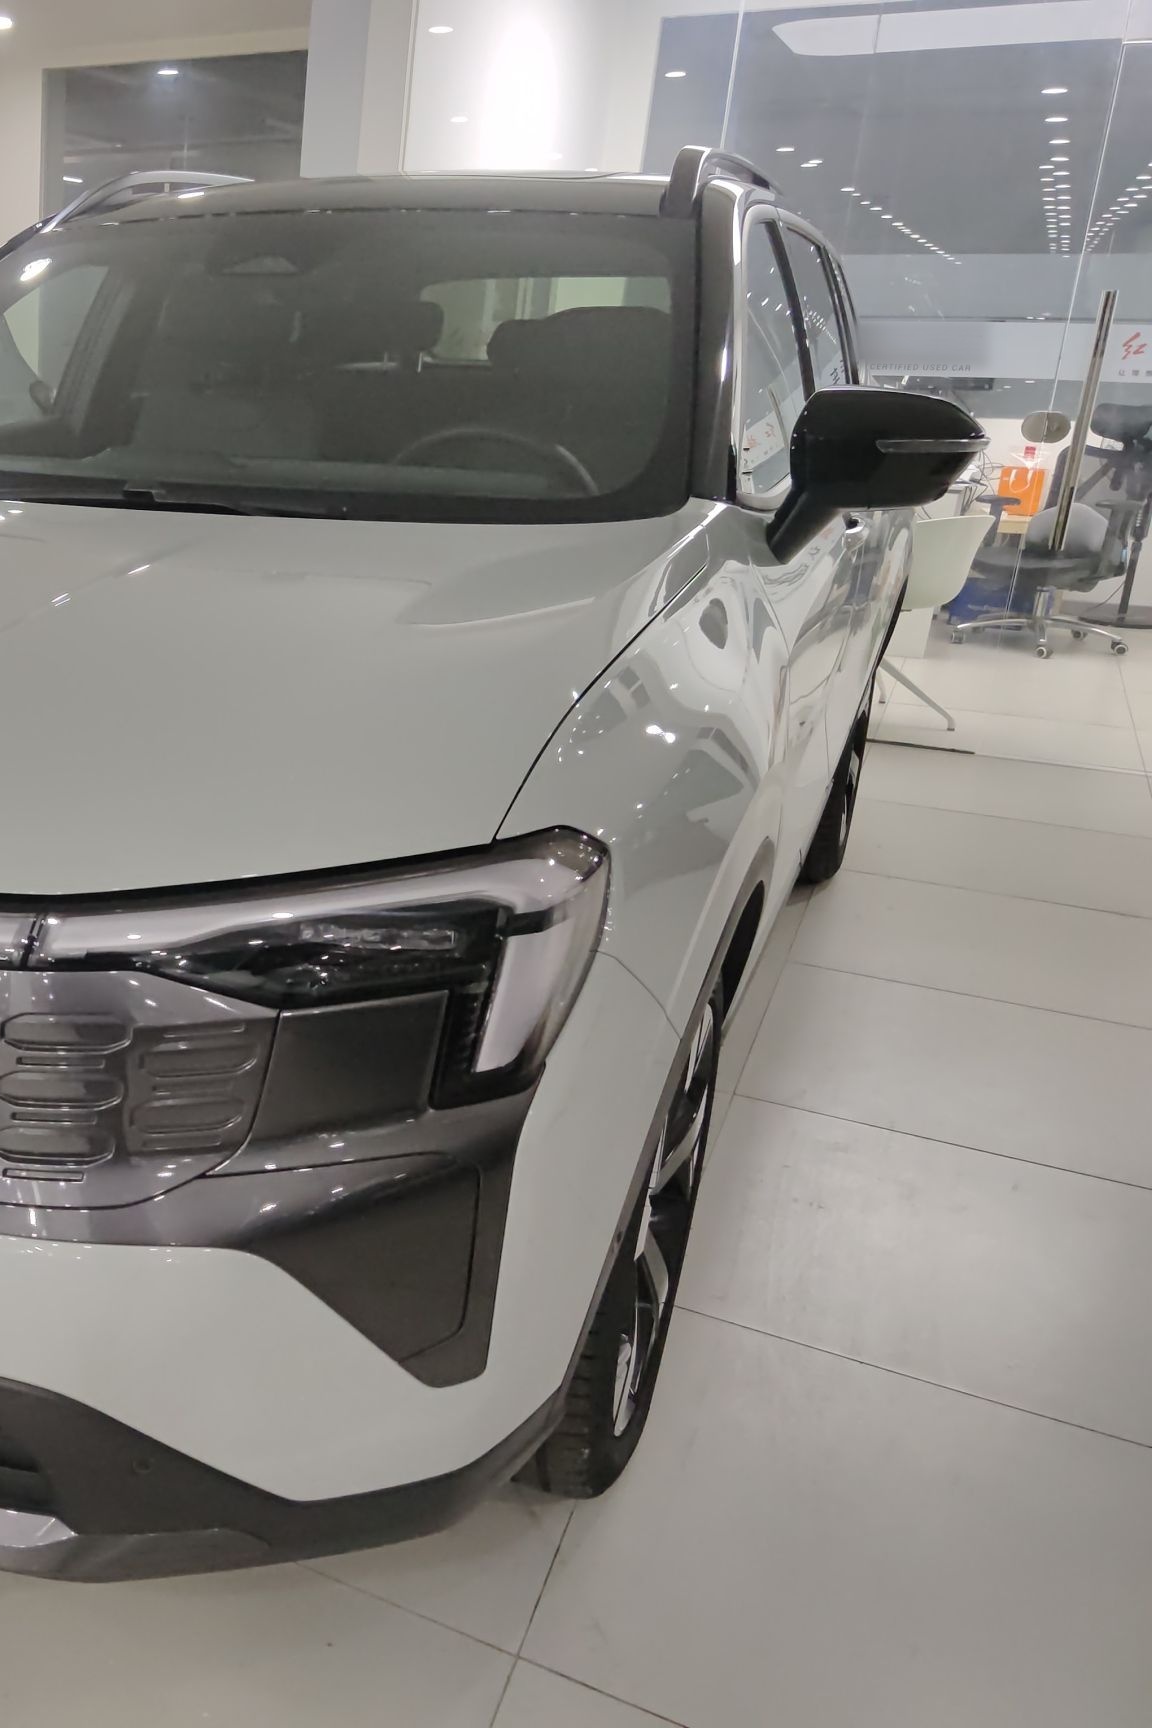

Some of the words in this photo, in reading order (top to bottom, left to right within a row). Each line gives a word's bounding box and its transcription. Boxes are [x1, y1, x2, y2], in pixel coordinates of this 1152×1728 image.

[869, 363, 919, 371] CERTIFIED
[923, 363, 948, 371] USED
[951, 364, 971, 372] CAR
